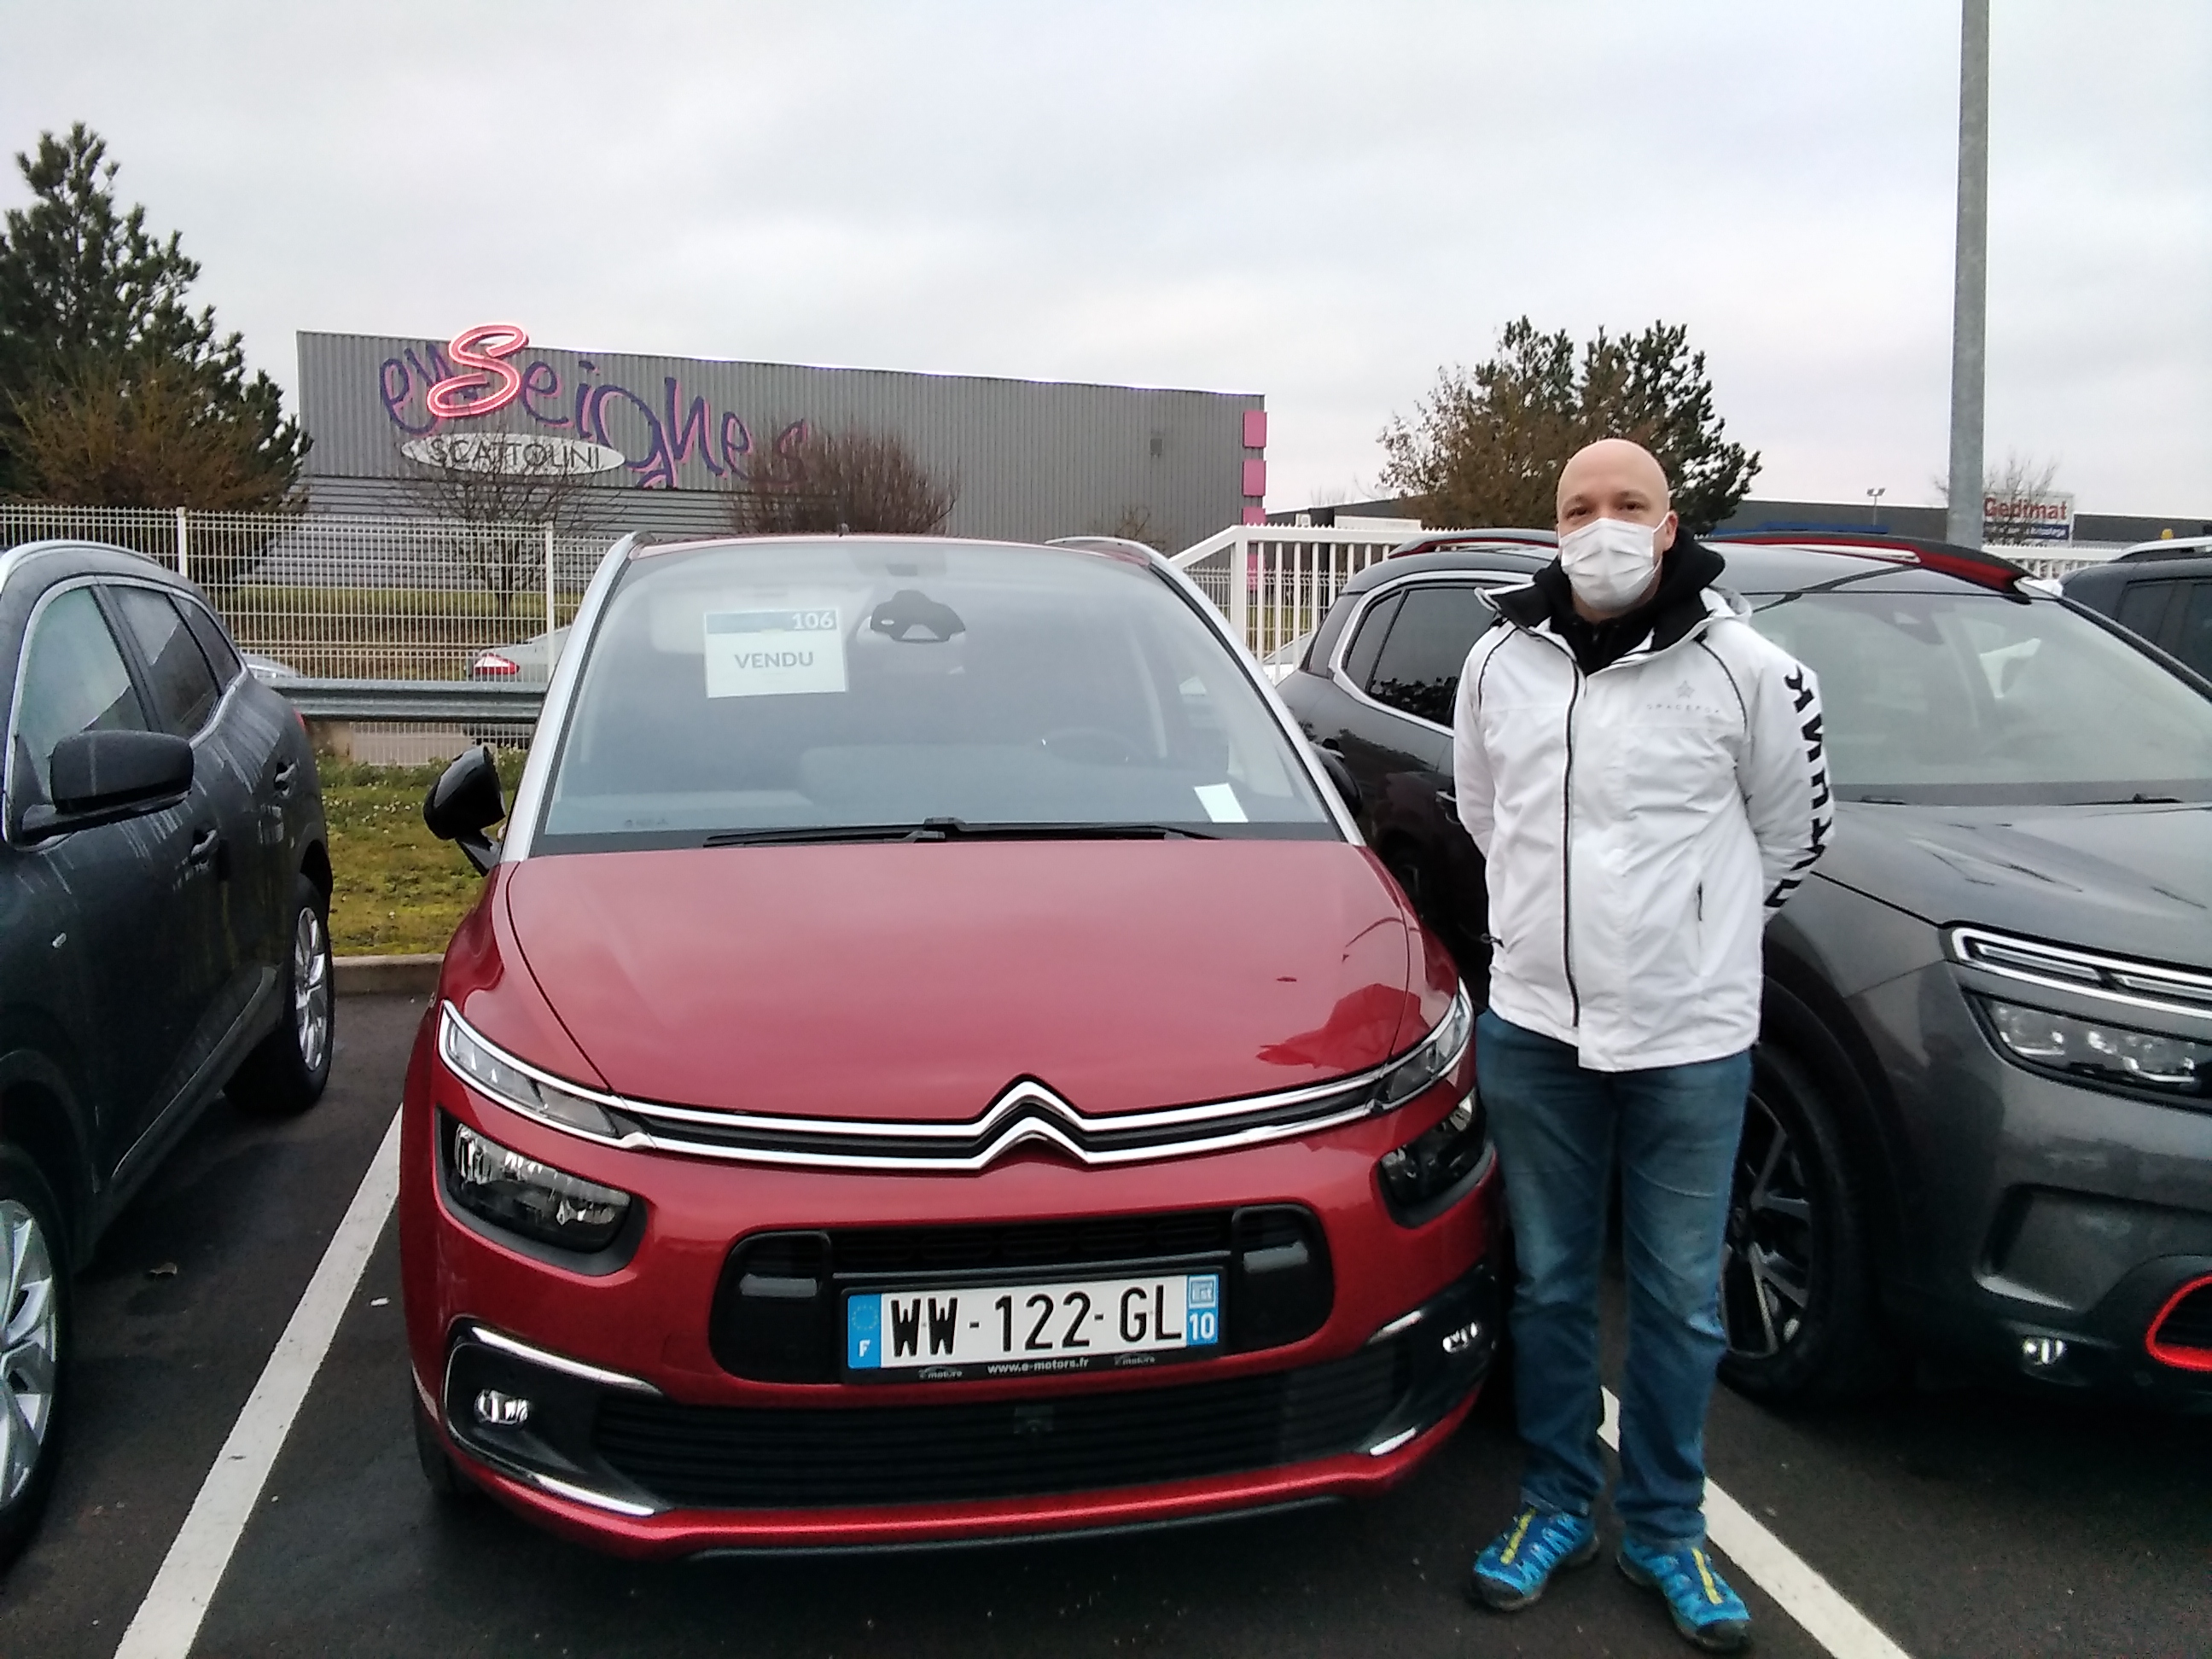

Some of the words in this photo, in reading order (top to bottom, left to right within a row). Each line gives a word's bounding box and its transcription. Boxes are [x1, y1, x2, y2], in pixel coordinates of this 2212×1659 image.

[430, 437, 599, 469] SCATTOLINI
[1984, 498, 2067, 520] Gedimat
[792, 612, 834, 630] 106
[734, 651, 814, 669] VENDU
[1190, 1312, 1214, 1341] 10
[859, 1340, 871, 1358] F
